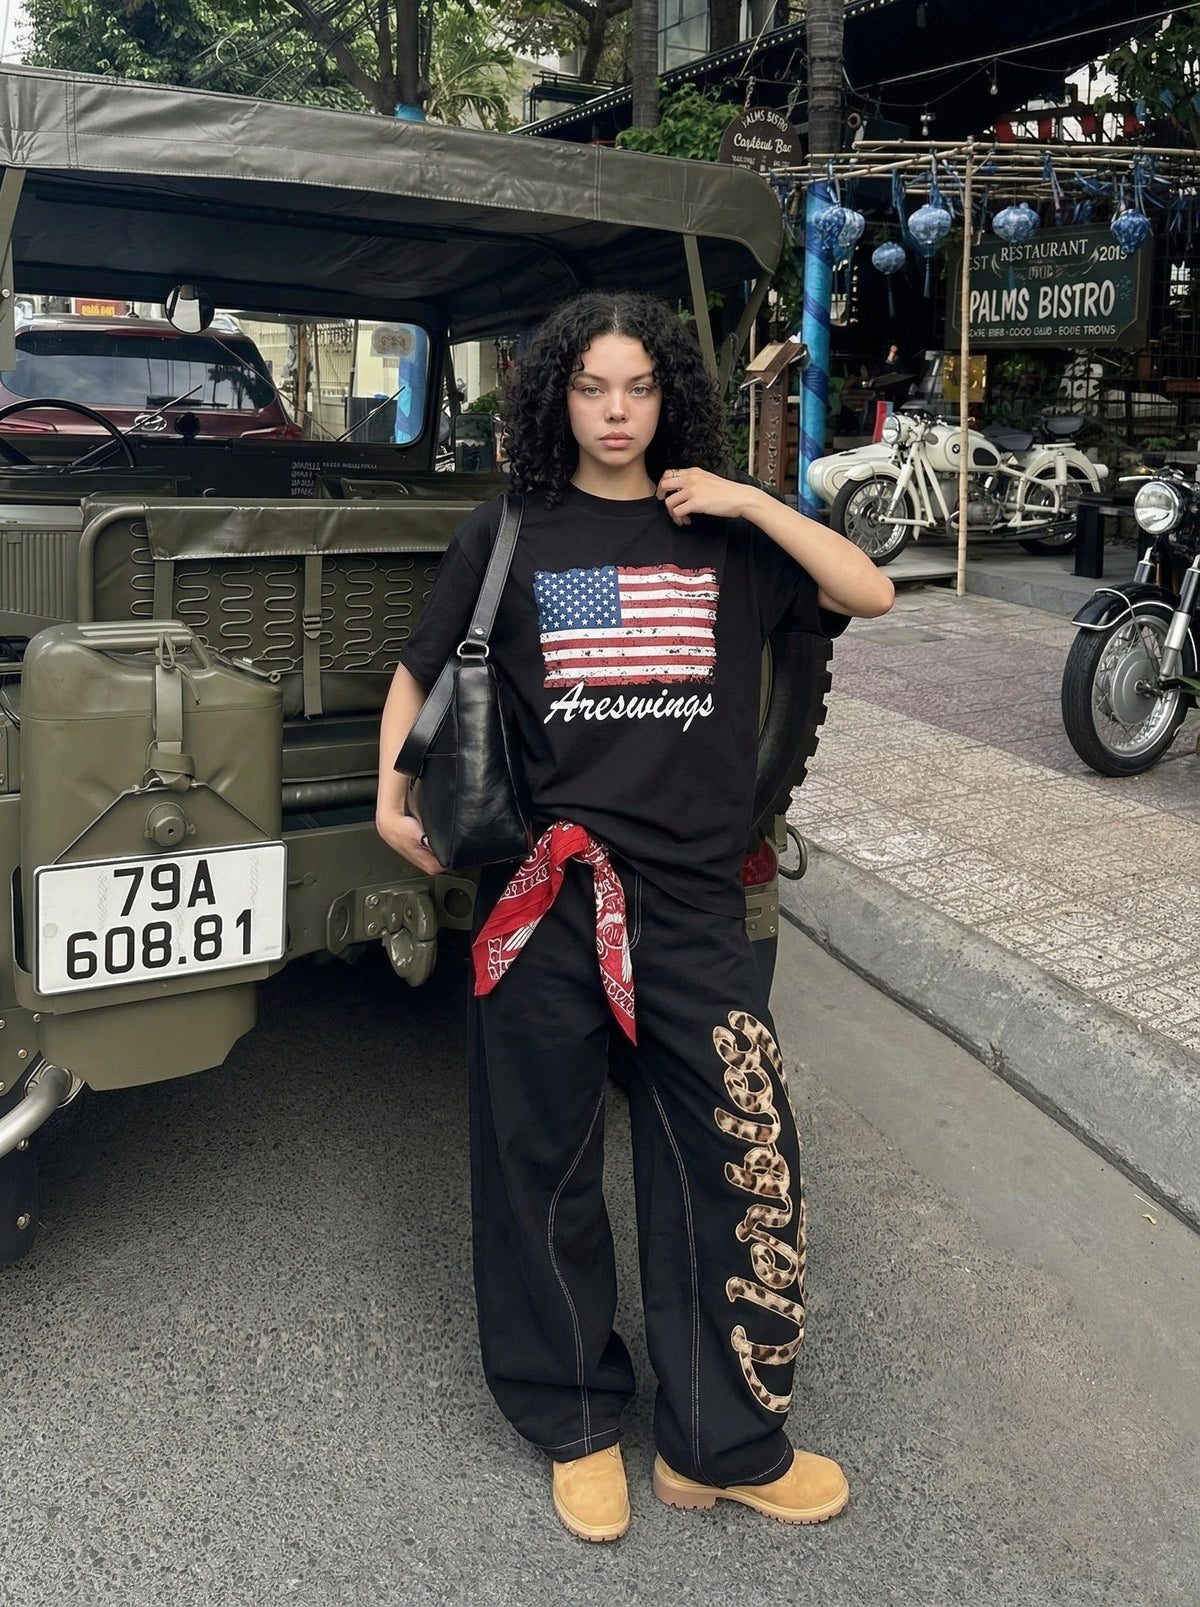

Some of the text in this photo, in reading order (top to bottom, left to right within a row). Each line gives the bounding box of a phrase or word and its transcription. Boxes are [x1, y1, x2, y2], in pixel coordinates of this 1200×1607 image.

[1000, 239, 1088, 261] RESTAURANT
[969, 279, 1116, 323] PALMS BISTRO
[543, 681, 715, 732] Areswings
[113, 859, 216, 917] 79A
[66, 908, 252, 981] 608.81
